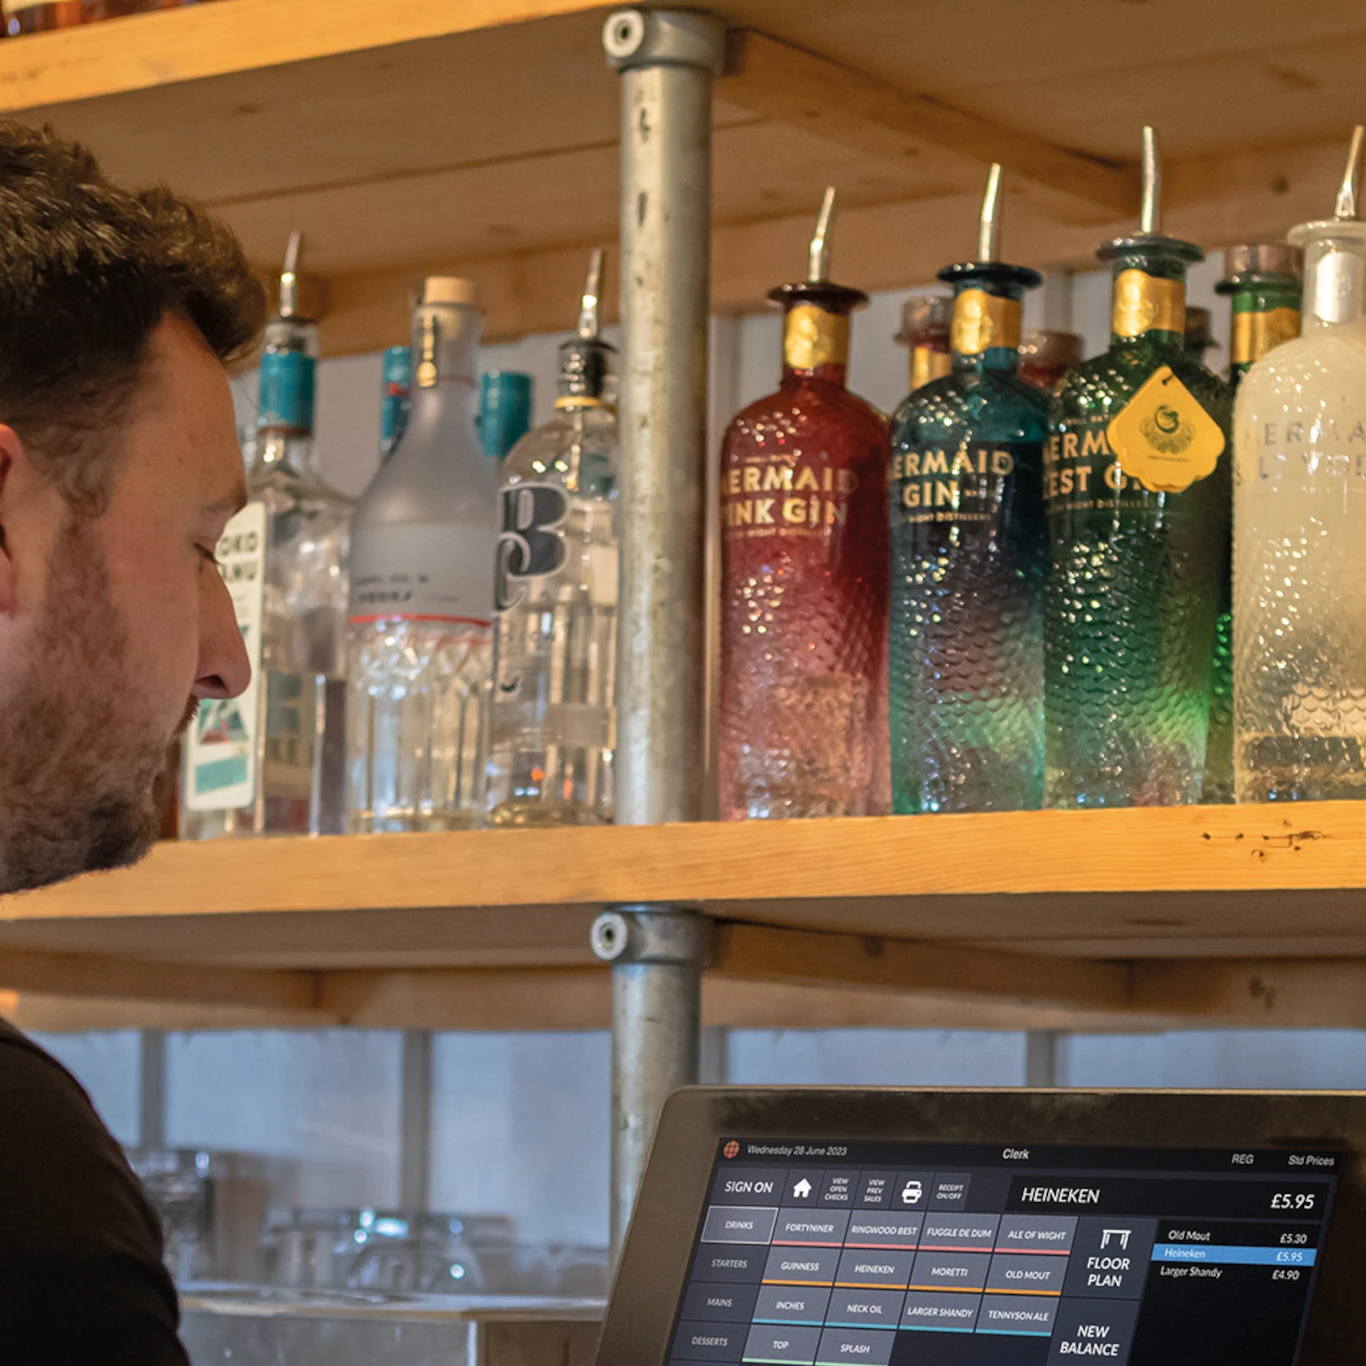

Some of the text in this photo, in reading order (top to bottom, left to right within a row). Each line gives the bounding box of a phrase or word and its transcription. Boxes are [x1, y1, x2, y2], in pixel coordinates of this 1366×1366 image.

[888, 449, 1014, 479] ERMAID
[723, 465, 858, 495] ERMAID
[903, 480, 960, 509] GIN
[722, 497, 848, 527] INK GIN
[747, 1145, 847, 1157] Wednesday 28 June 2023
[1002, 1148, 1030, 1159] Clerk
[1231, 1153, 1254, 1165] REG
[1288, 1154, 1335, 1167] Std Prices
[724, 1181, 773, 1194] SIGN ON
[1021, 1187, 1100, 1204] HEINEKEN
[1270, 1193, 1315, 1210] £5.95
[725, 1220, 754, 1230] DRINKS
[785, 1223, 834, 1233] FORTYNINER
[851, 1225, 918, 1236] RINGWOOD BEST
[926, 1227, 992, 1238] FUGGLE DE DUM
[1007, 1230, 1066, 1240] ALE OF WIGHT
[1168, 1230, 1211, 1241] Old Mout
[1280, 1233, 1308, 1245] £5.30
[1164, 1248, 1206, 1260] Heineken
[1276, 1251, 1303, 1262] £5.95
[711, 1259, 748, 1269] STARTERS
[780, 1261, 820, 1272] GUINNESS
[1087, 1256, 1131, 1270] FLOOR
[854, 1264, 895, 1274] HEINEKEN
[931, 1267, 968, 1277] MORETTI
[1160, 1266, 1223, 1279] Larger Shandy
[1005, 1270, 1051, 1280] OLD MOUT
[1087, 1274, 1122, 1287] PLAN
[1272, 1269, 1300, 1281] £4.90
[706, 1298, 732, 1307] MAINS
[776, 1301, 805, 1310] INCHES
[846, 1304, 883, 1314] NECK OIL
[907, 1307, 974, 1318] LARGER SHANDY
[988, 1310, 1050, 1321] TENNYSON ALE
[1077, 1325, 1110, 1338] NEW
[691, 1336, 728, 1347] DESSERTS
[773, 1340, 790, 1350] TOP
[840, 1344, 870, 1354] SPLASH
[1059, 1341, 1120, 1356] BALANCE
